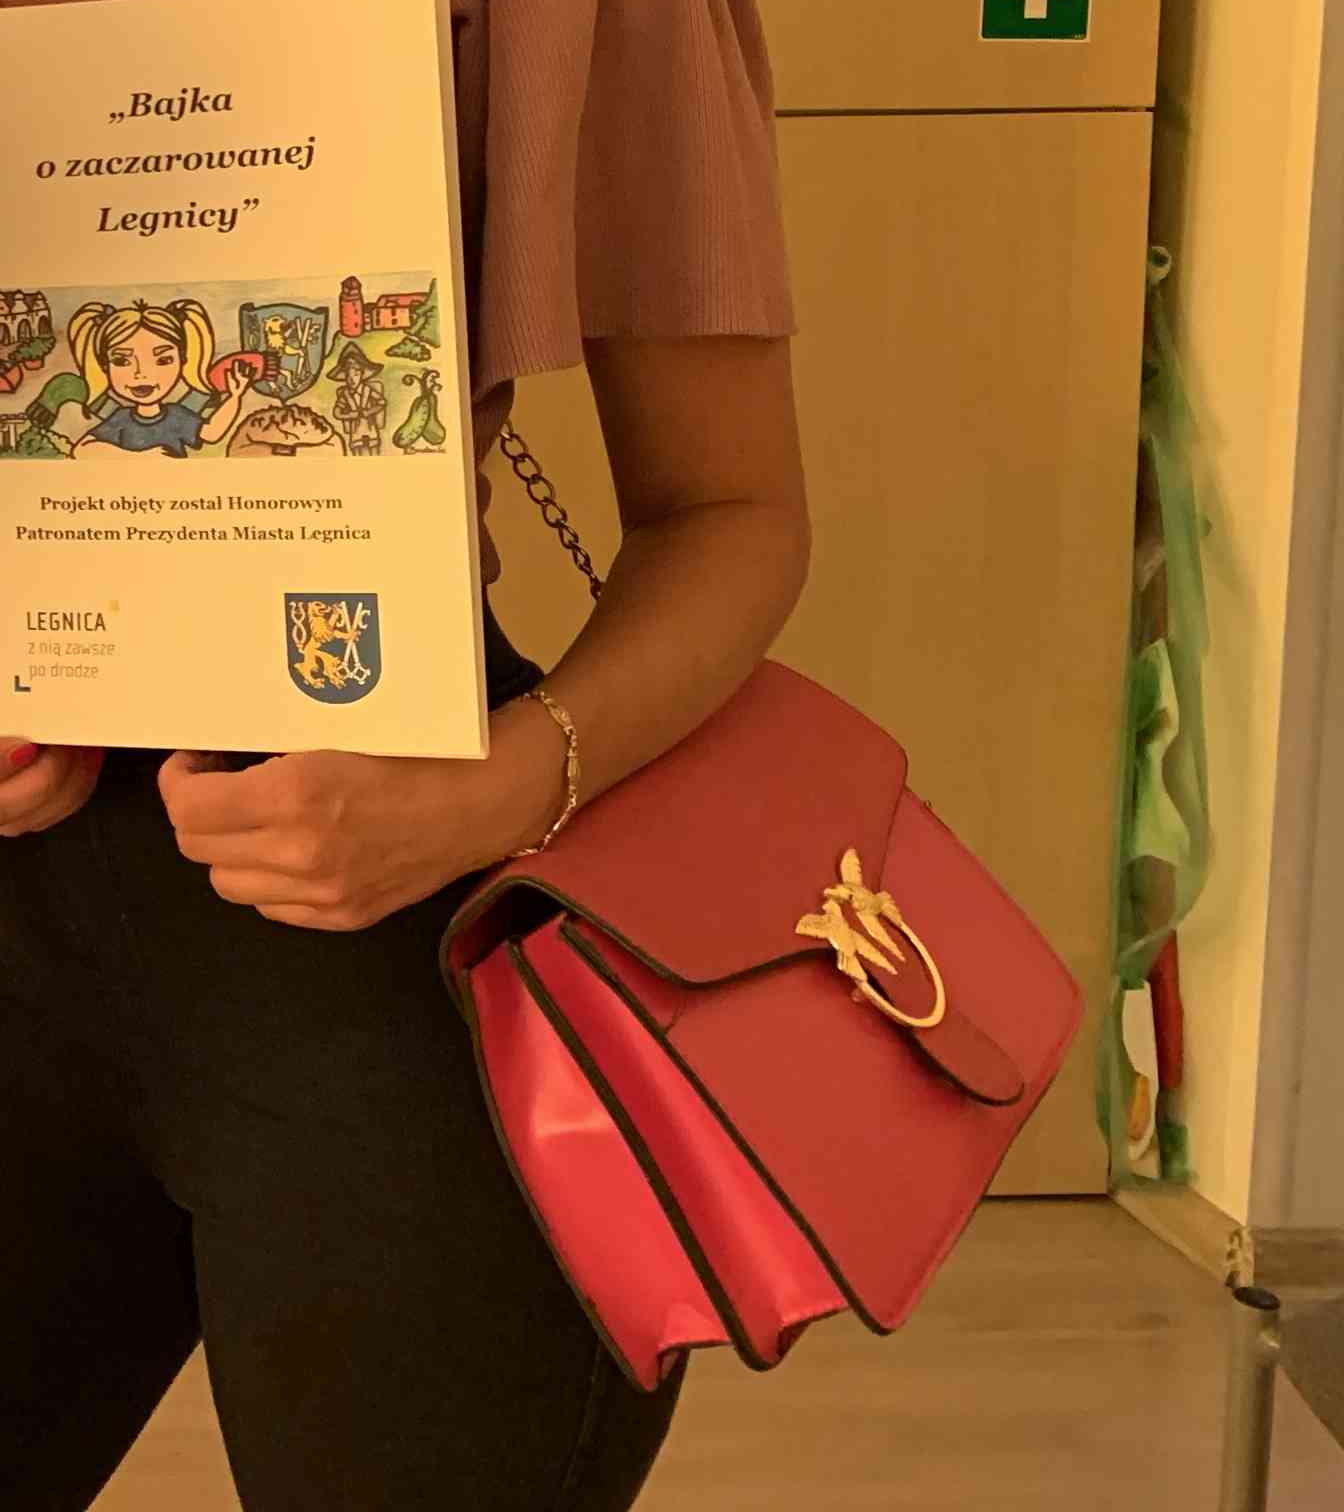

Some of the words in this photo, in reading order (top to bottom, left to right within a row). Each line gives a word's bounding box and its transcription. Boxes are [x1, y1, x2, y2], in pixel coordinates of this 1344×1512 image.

[109, 87, 232, 124] „Bajka
[36, 159, 55, 179] o
[65, 136, 316, 178] zaczarowanej
[97, 198, 260, 235] Legnicy”
[40, 496, 105, 514] Projekt
[110, 496, 165, 514] objęty
[228, 496, 343, 514] Honorowym
[15, 526, 121, 541] Patronatem
[126, 526, 227, 544] Prezydenta
[233, 526, 295, 540] Miasta
[300, 526, 371, 544] Legnica
[27, 612, 106, 632] LEGNICA
[28, 644, 35, 655] z
[40, 641, 61, 658] nią
[65, 642, 116, 655] zawsze
[29, 665, 46, 681] po
[50, 663, 99, 678] drodze
